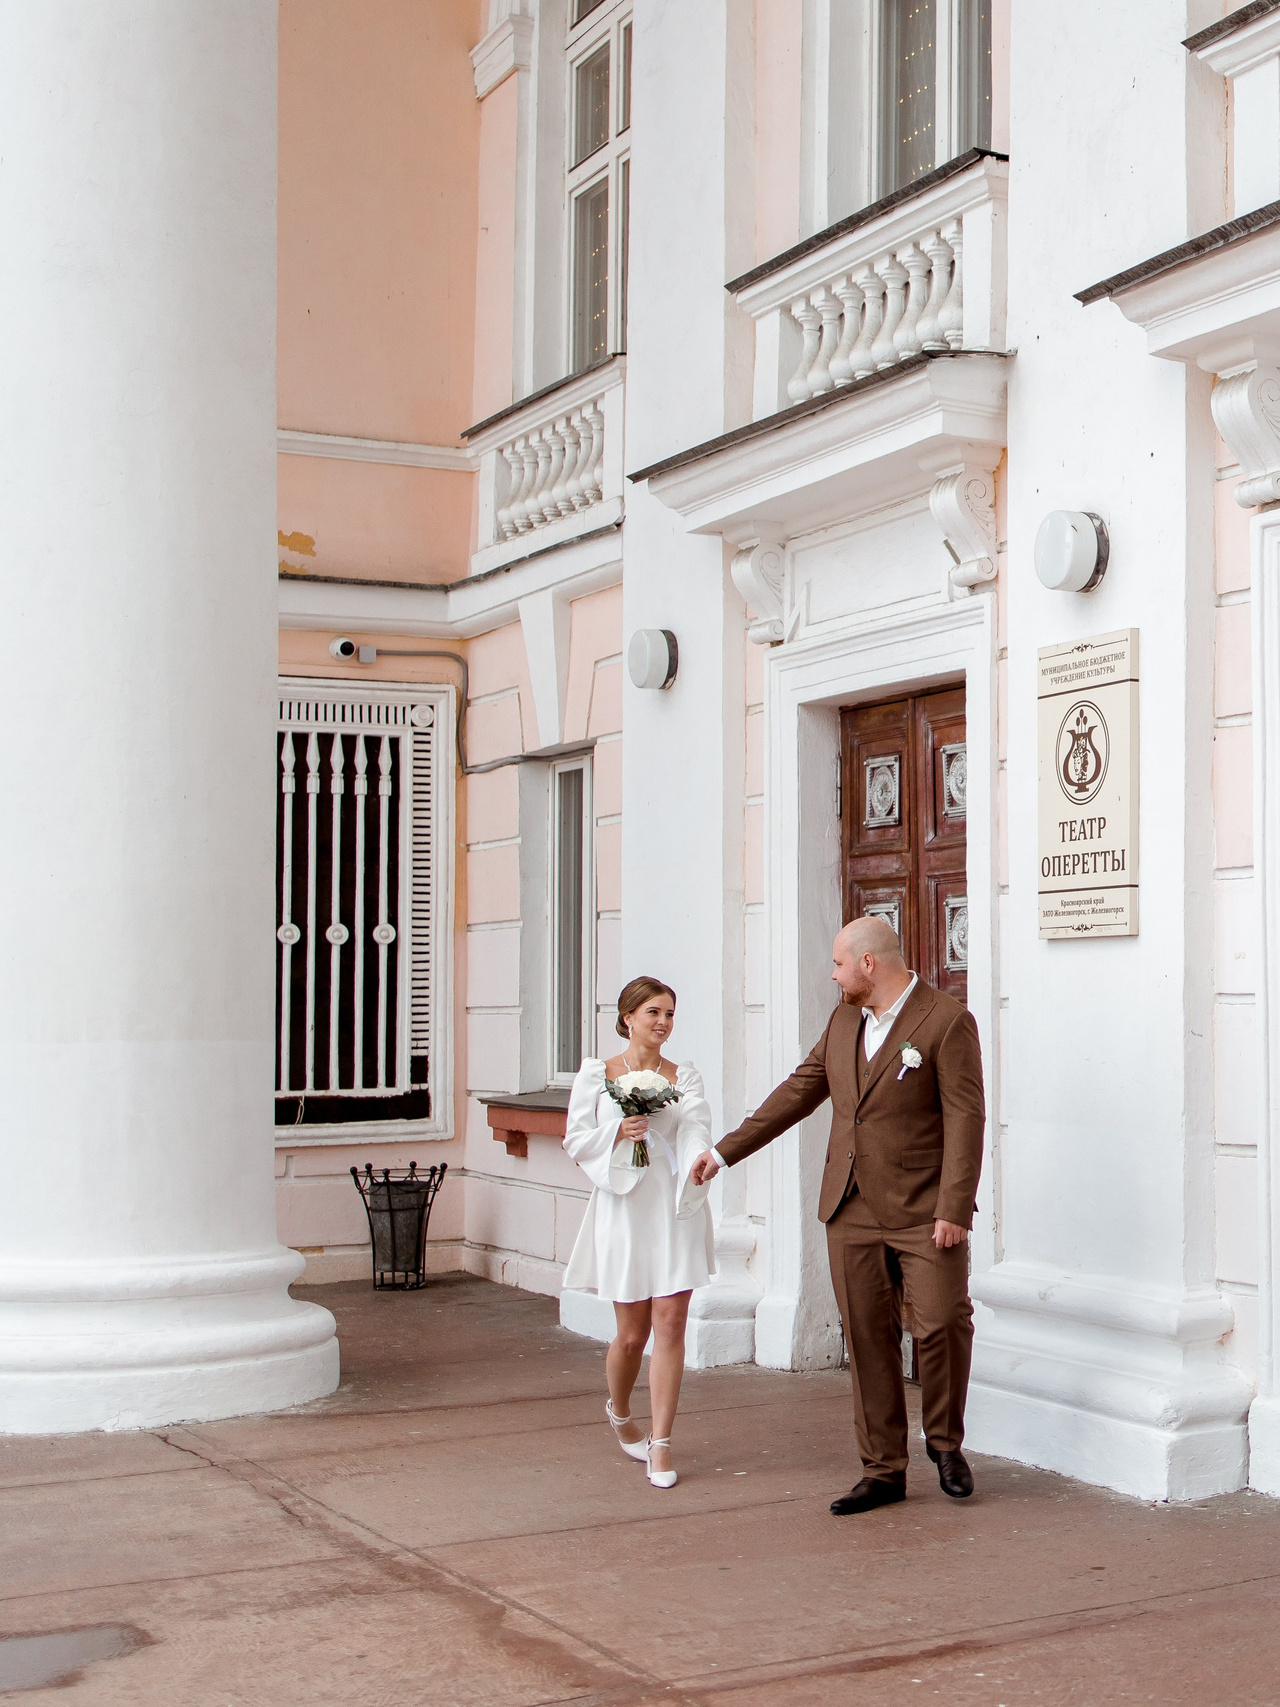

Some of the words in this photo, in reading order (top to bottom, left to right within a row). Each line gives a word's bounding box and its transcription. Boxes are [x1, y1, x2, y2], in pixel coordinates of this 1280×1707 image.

[1041, 660, 1089, 677] МУНИЦИПАЛЬНОЕ
[1090, 651, 1126, 667] БЮДЖЕТНОЕ
[1050, 671, 1086, 686] УЧРЕЖДЕНИЕ
[1086, 665, 1116, 678] КУЛЬТУРЫ
[1058, 816, 1107, 843] ТЕАТР
[1041, 849, 1126, 878] ОПЕРЕТТЫ
[1060, 898, 1092, 909] Красноярский
[1092, 897, 1105, 906] край
